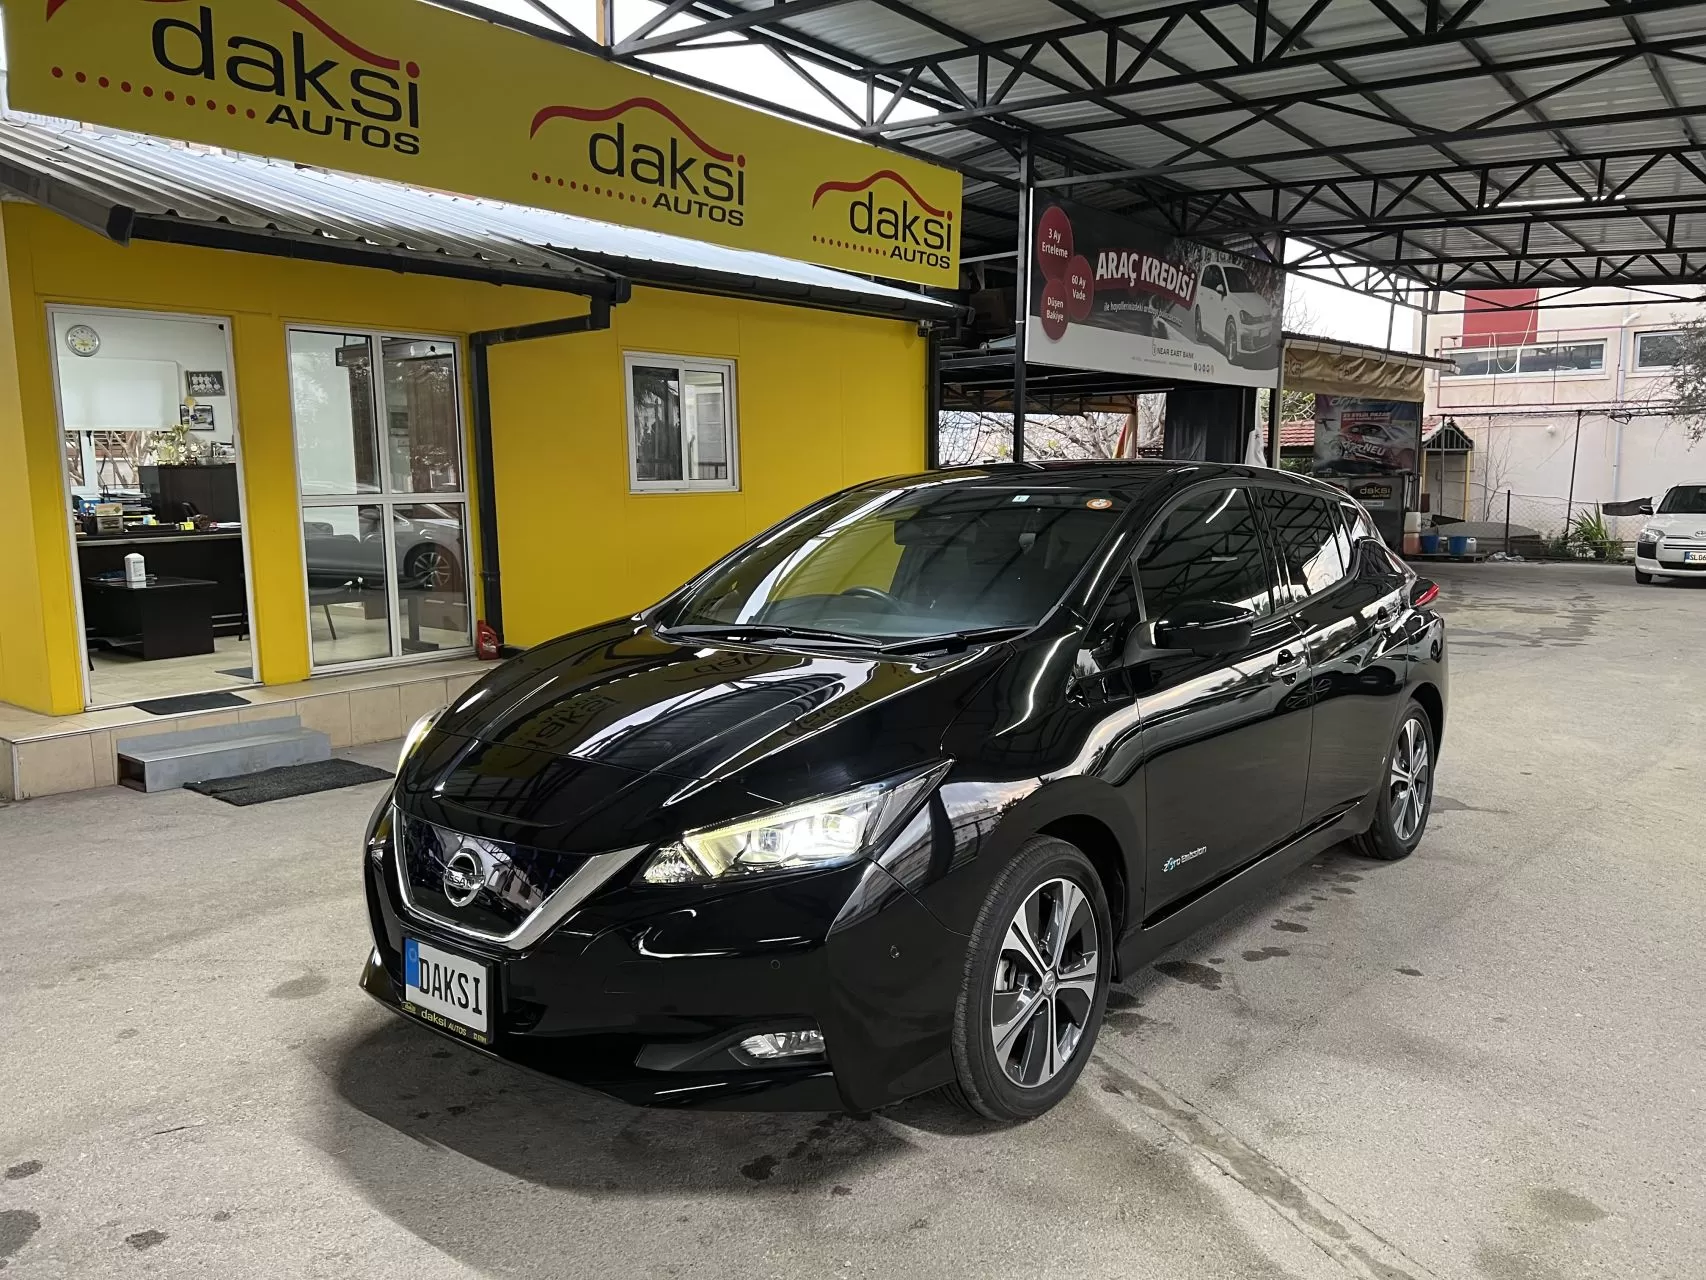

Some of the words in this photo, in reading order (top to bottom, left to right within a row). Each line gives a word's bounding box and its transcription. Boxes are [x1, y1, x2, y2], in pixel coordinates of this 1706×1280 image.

[151, 5, 421, 129] daksi
[265, 104, 420, 155] AUTOS
[589, 122, 746, 206] daksi
[652, 192, 744, 227] AUTOS
[849, 191, 953, 253] daksi
[1048, 228, 1053, 238] 3
[1053, 229, 1061, 244] Ay
[890, 245, 951, 269] AUTOS
[1041, 241, 1069, 258] Erteleme
[1071, 274, 1079, 285] 60
[1079, 277, 1086, 289] Ay
[1095, 251, 1139, 287] ARAÇ
[1140, 255, 1195, 301] KREDİSİ
[1047, 296, 1064, 309] Düşen
[1072, 289, 1086, 301] Vade
[1046, 310, 1064, 323] Bakiye
[1157, 347, 1170, 355] NEAR
[1170, 349, 1182, 357] EAST
[419, 957, 483, 1015] DAKSI
[421, 1009, 447, 1028] daksi
[447, 1022, 467, 1036] AUTOS
